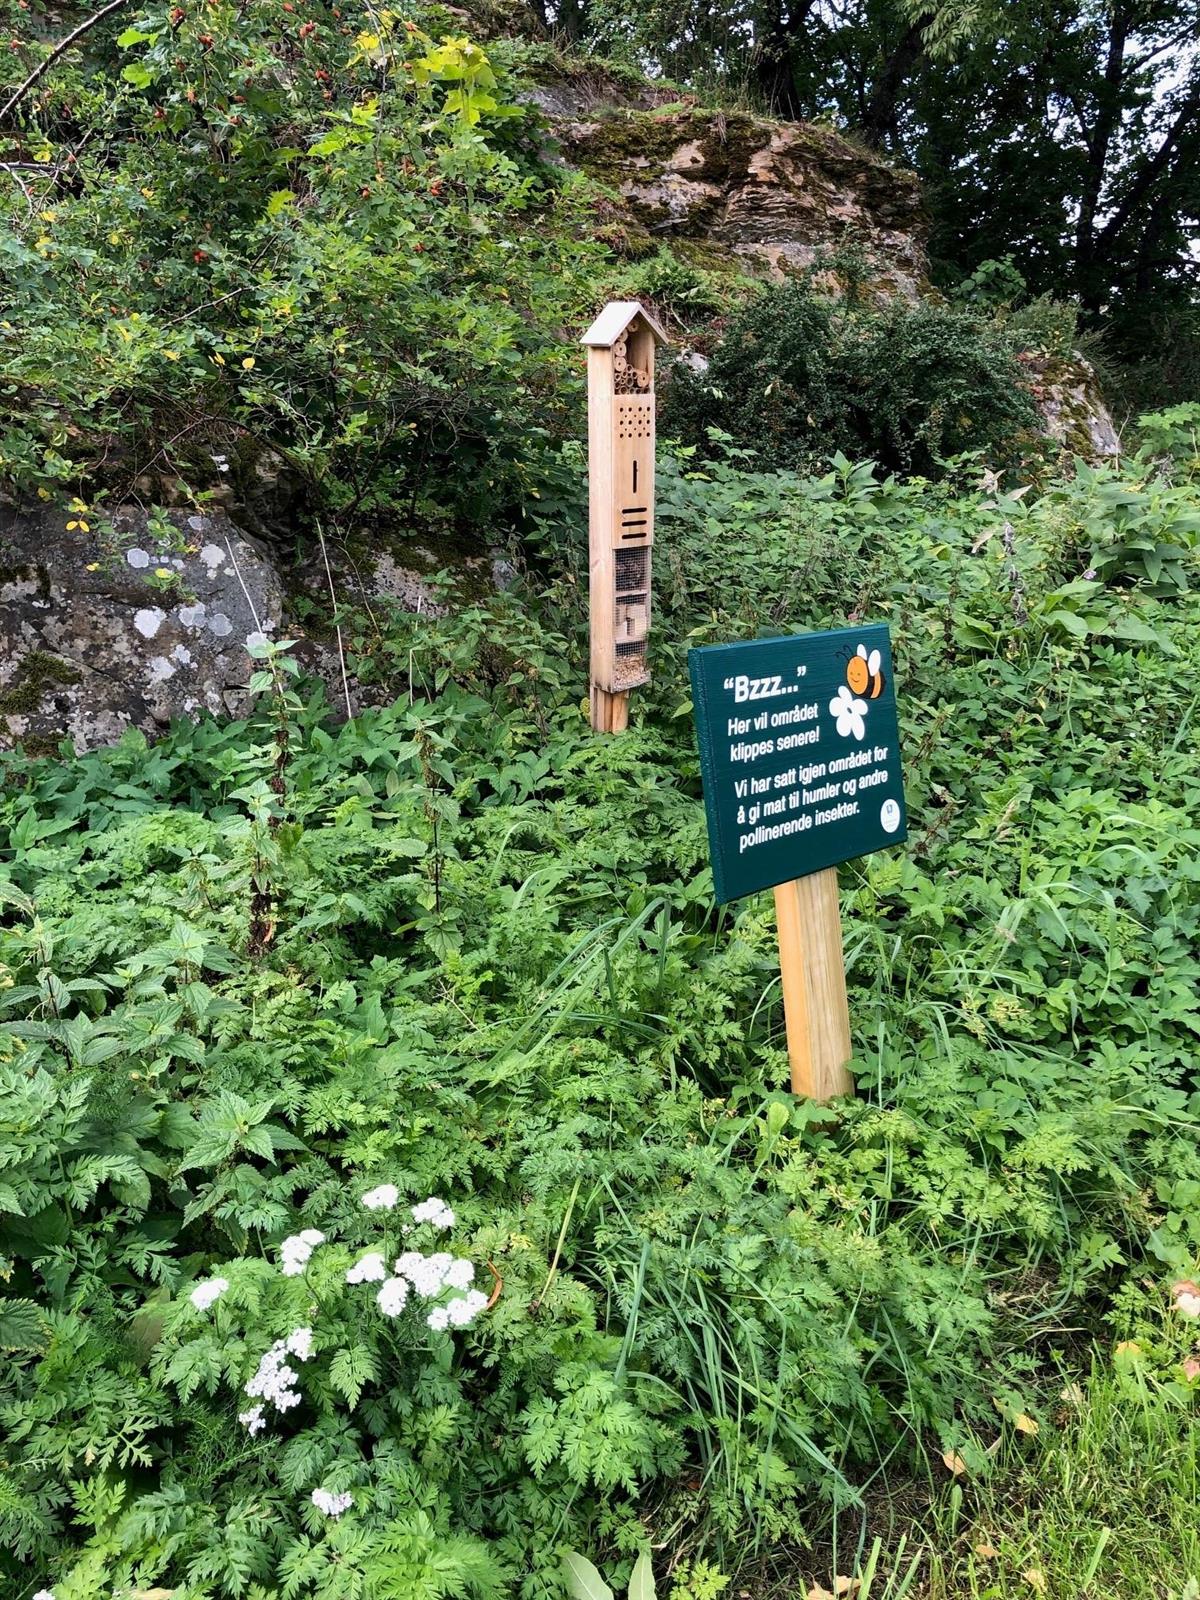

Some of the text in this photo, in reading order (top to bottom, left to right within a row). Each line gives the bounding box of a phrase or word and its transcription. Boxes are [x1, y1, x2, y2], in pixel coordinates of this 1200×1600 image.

[728, 703, 818, 736] Her vil området
[730, 726, 820, 763] klippes senere!
[734, 746, 888, 798] Vi har satt igjen området for
[737, 769, 888, 825] å gi mat til humler og andre
[740, 801, 860, 853] pollinerende insekter.
